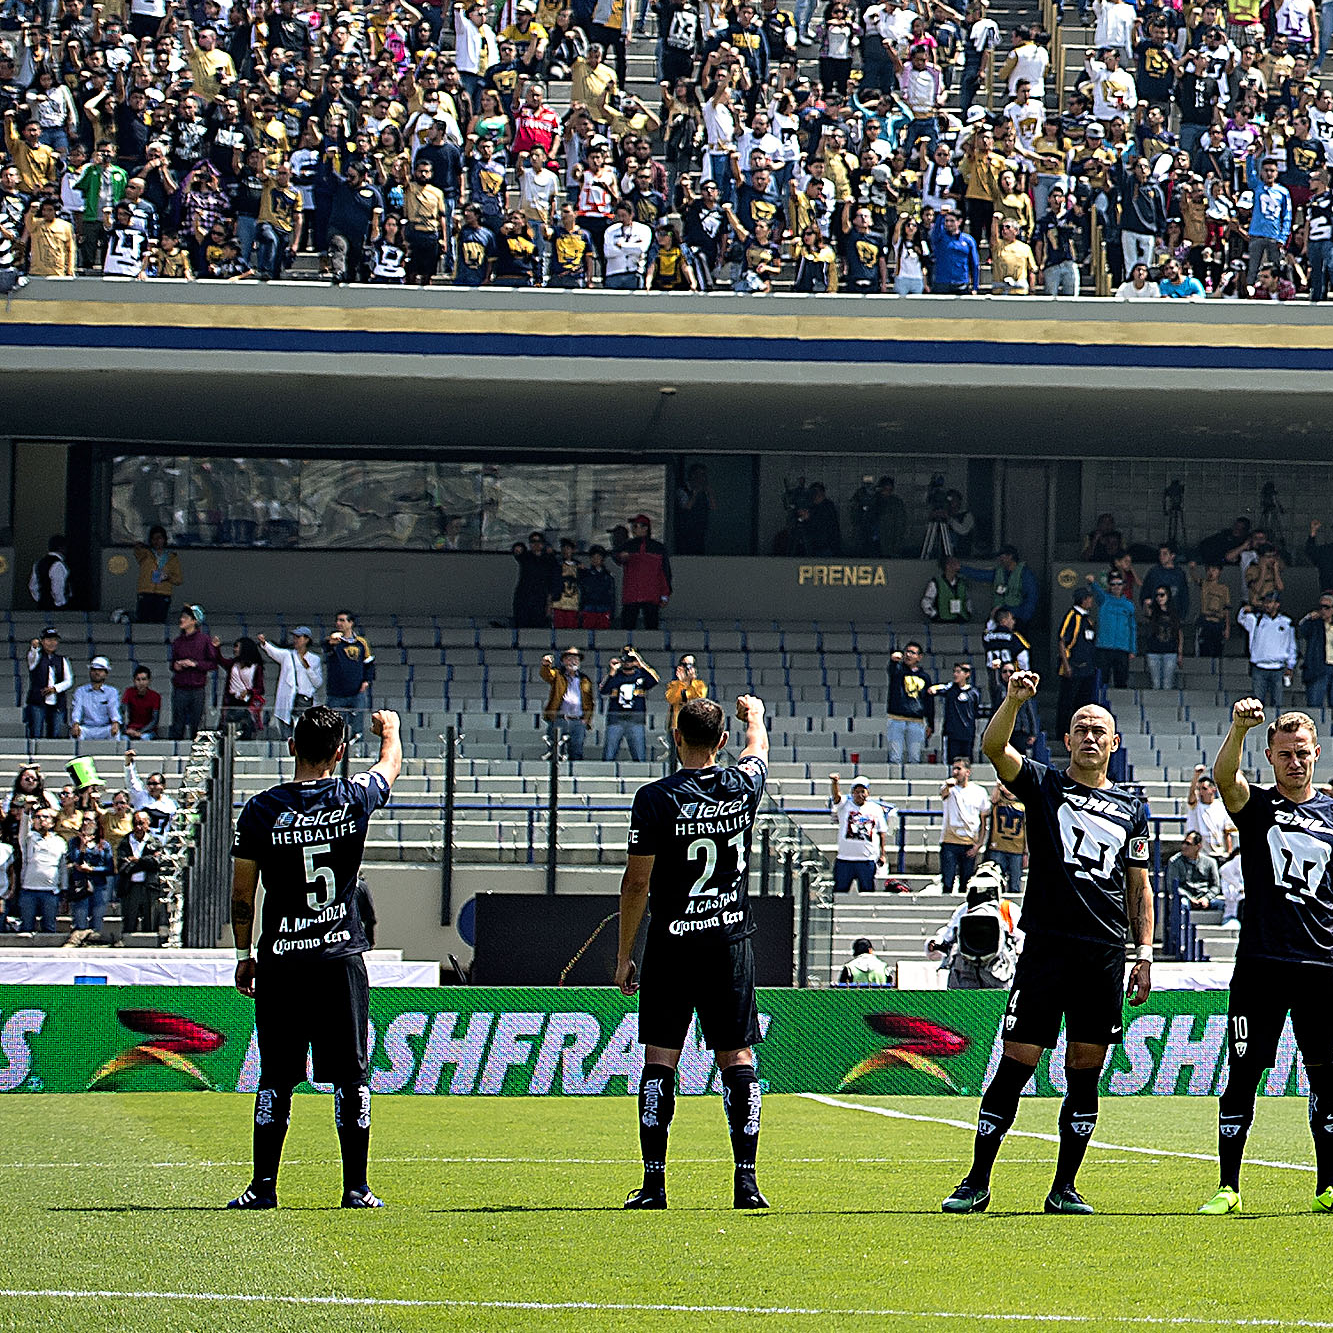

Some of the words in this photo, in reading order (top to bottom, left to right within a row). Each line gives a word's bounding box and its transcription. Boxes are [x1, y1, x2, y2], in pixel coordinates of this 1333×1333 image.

[798, 565, 888, 586] PRENSA
[294, 803, 350, 828] telcel
[696, 794, 748, 819] telcel
[272, 820, 357, 845] HERBALIFE
[675, 812, 751, 836] HERBALIFE
[687, 831, 747, 898] 21
[303, 843, 336, 912] 5
[279, 917, 292, 933] A.
[668, 916, 720, 936] Corona
[272, 937, 320, 955] Corona
[1009, 990, 1021, 1013] 4
[1232, 1016, 1248, 1040] 10
